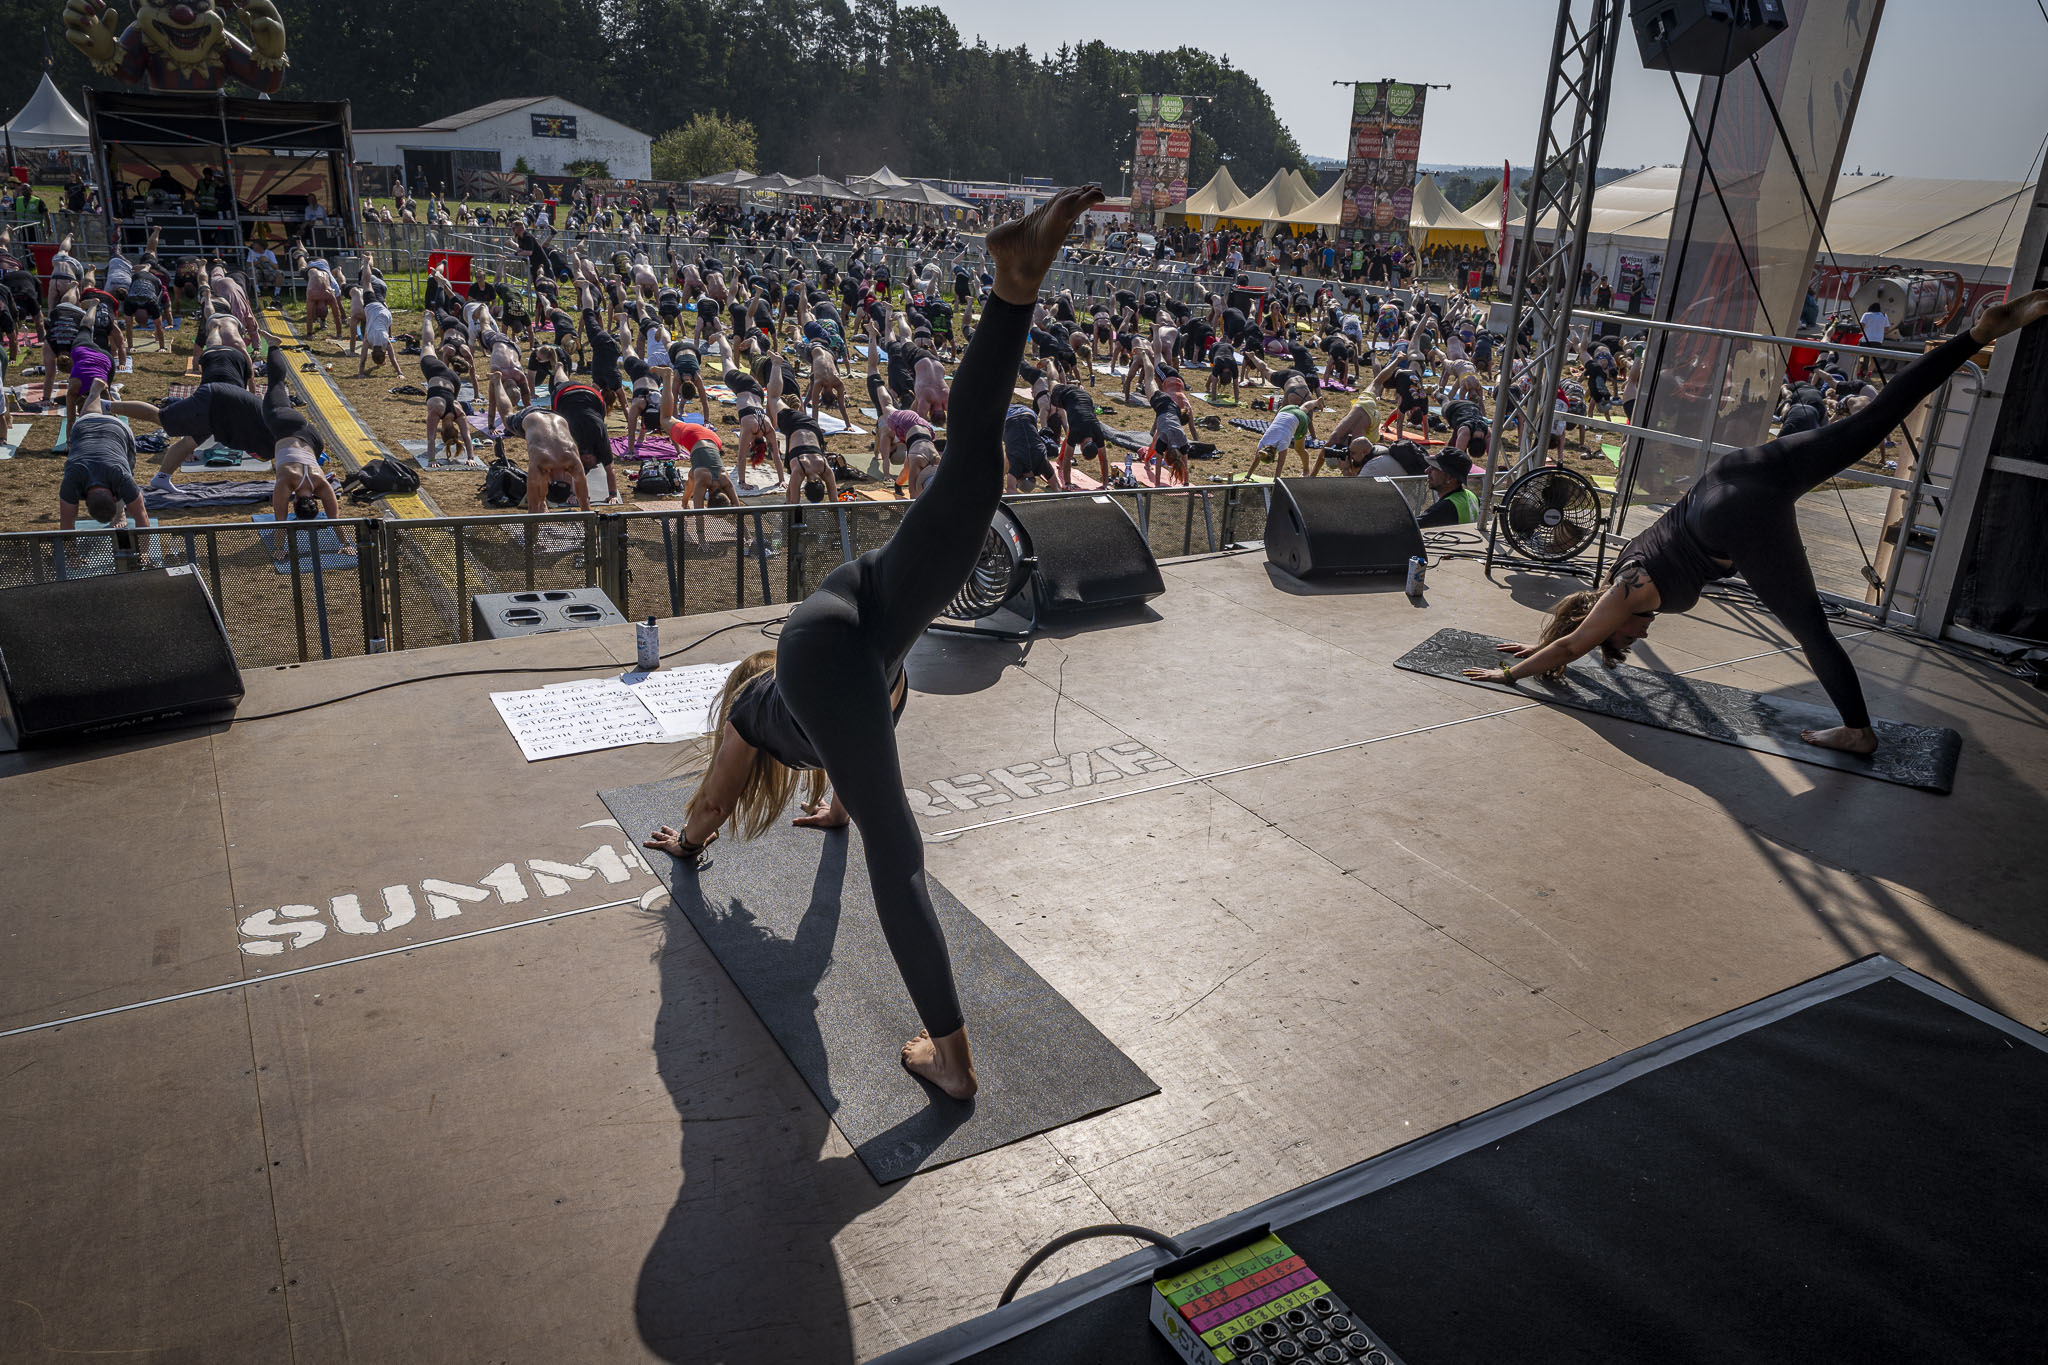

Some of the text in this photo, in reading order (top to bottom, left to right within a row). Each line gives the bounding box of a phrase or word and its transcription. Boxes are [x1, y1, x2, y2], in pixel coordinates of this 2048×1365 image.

[1390, 96, 1412, 105] KUCHEN
[1385, 160, 1403, 168] KAFFEE
[502, 687, 584, 703] YEAR ZERO
[524, 731, 572, 744] SOUTH
[602, 717, 655, 731] HEAVEN
